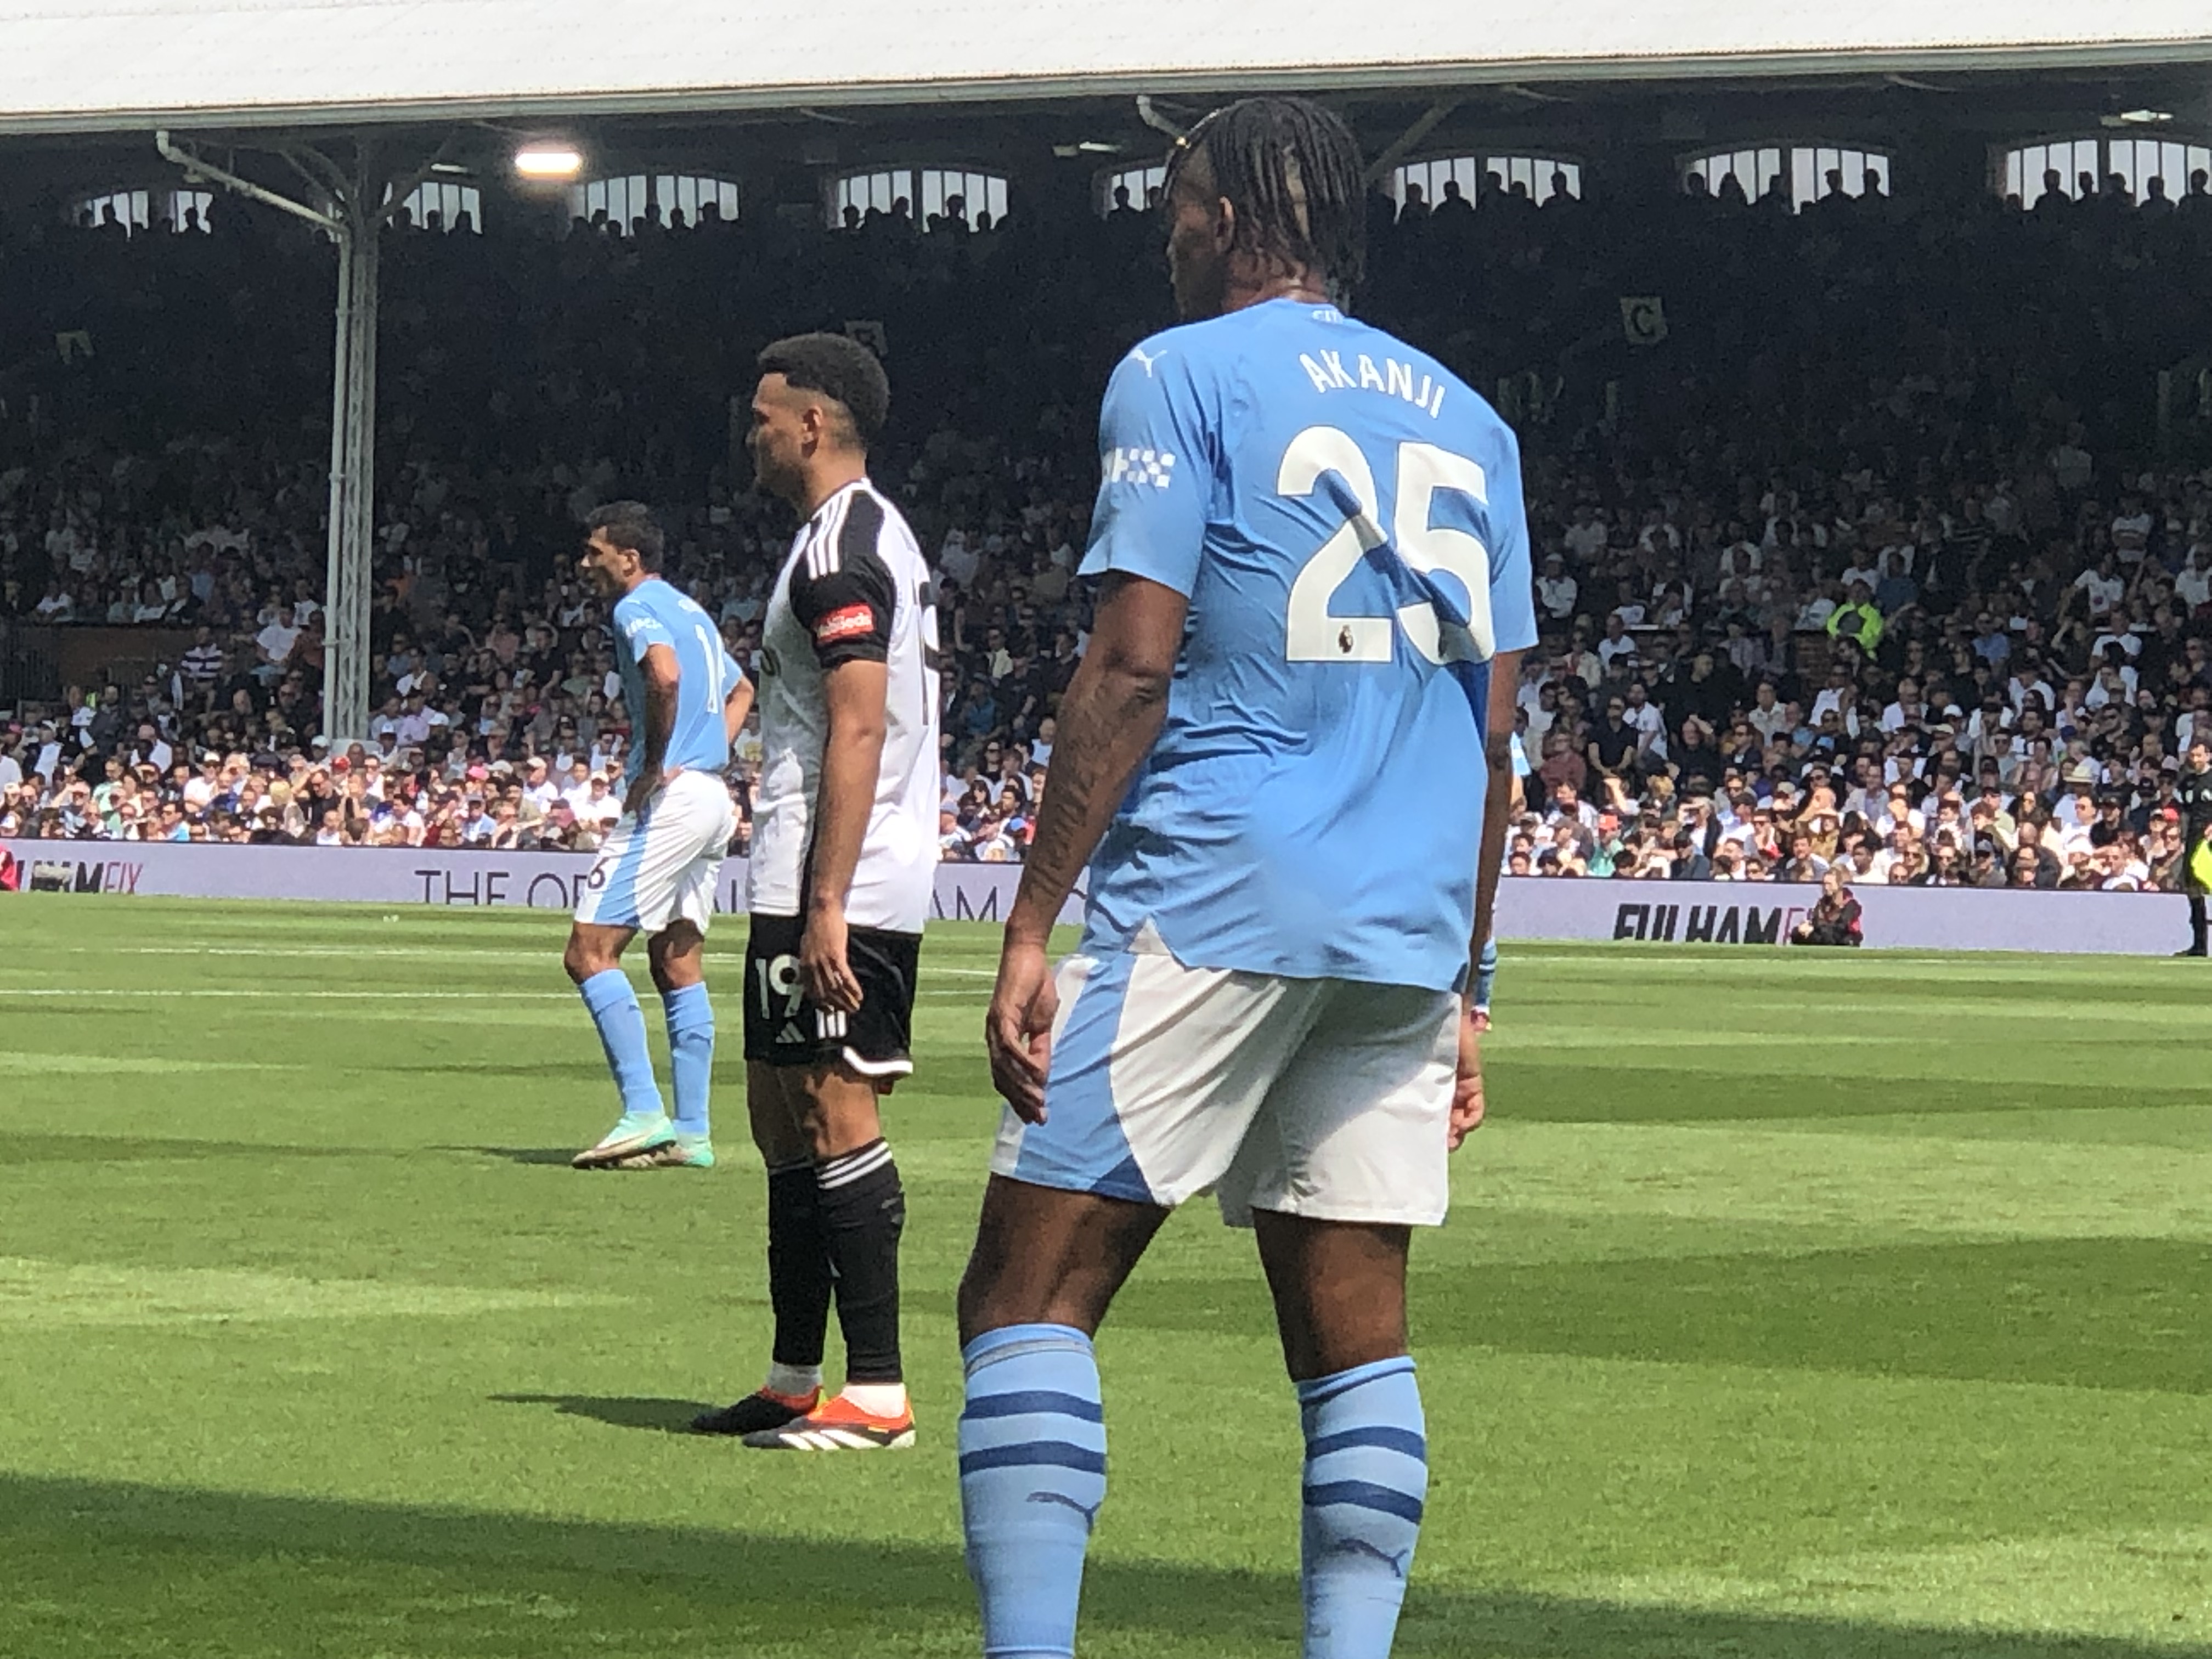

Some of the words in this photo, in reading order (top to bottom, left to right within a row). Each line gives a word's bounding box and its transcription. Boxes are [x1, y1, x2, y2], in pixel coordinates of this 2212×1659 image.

[1630, 304, 1655, 336] C
[1299, 349, 1446, 420] AKANJI
[1277, 425, 1496, 665] 25
[755, 953, 805, 1020] 19
